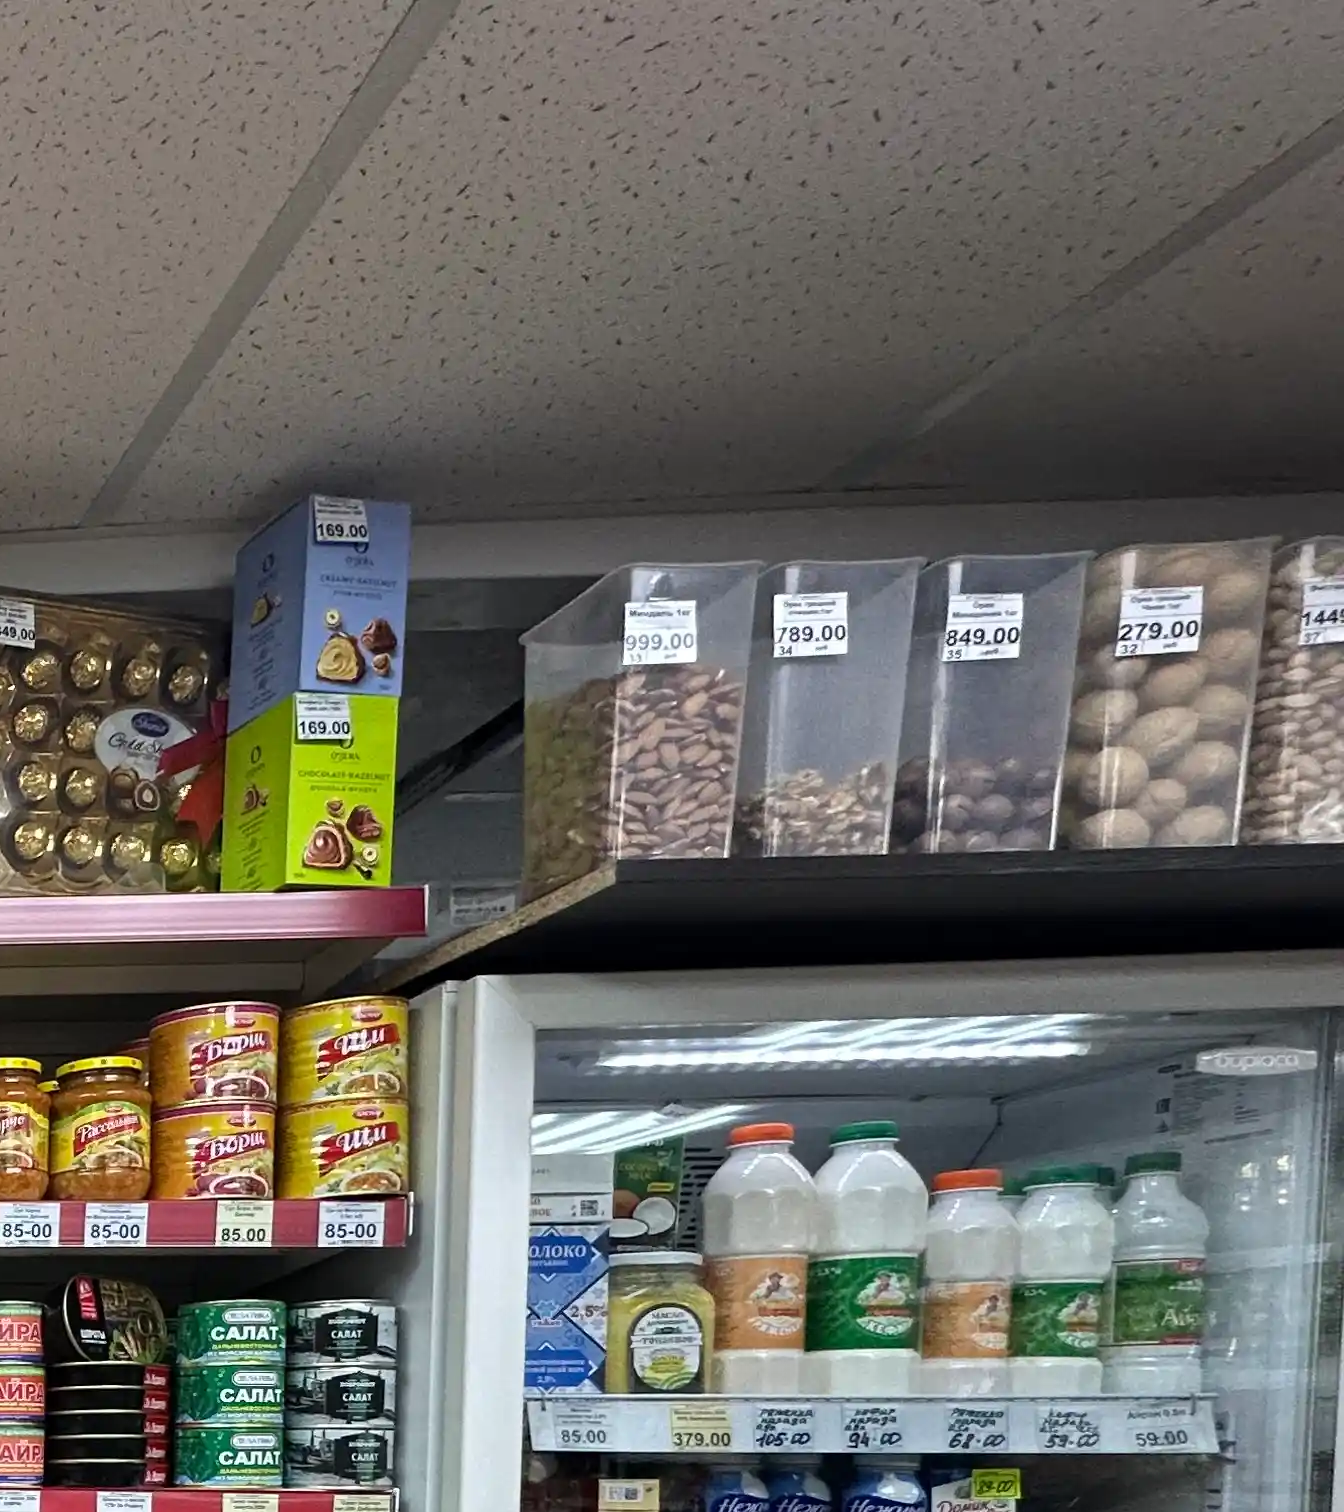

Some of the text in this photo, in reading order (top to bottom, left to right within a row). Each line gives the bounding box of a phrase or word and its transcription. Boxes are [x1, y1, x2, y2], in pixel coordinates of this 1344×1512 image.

[316, 521, 367, 539] 169.00
[776, 622, 847, 645] 789.00
[946, 624, 1020, 646] 849.00
[1118, 618, 1200, 641] 279.00
[624, 631, 694, 653] 999.00
[778, 644, 793, 657] 34
[1122, 643, 1139, 655] 32
[946, 648, 963, 660] 35
[211, 1325, 279, 1342] САЛАТ
[673, 1430, 731, 1448] 379.00
